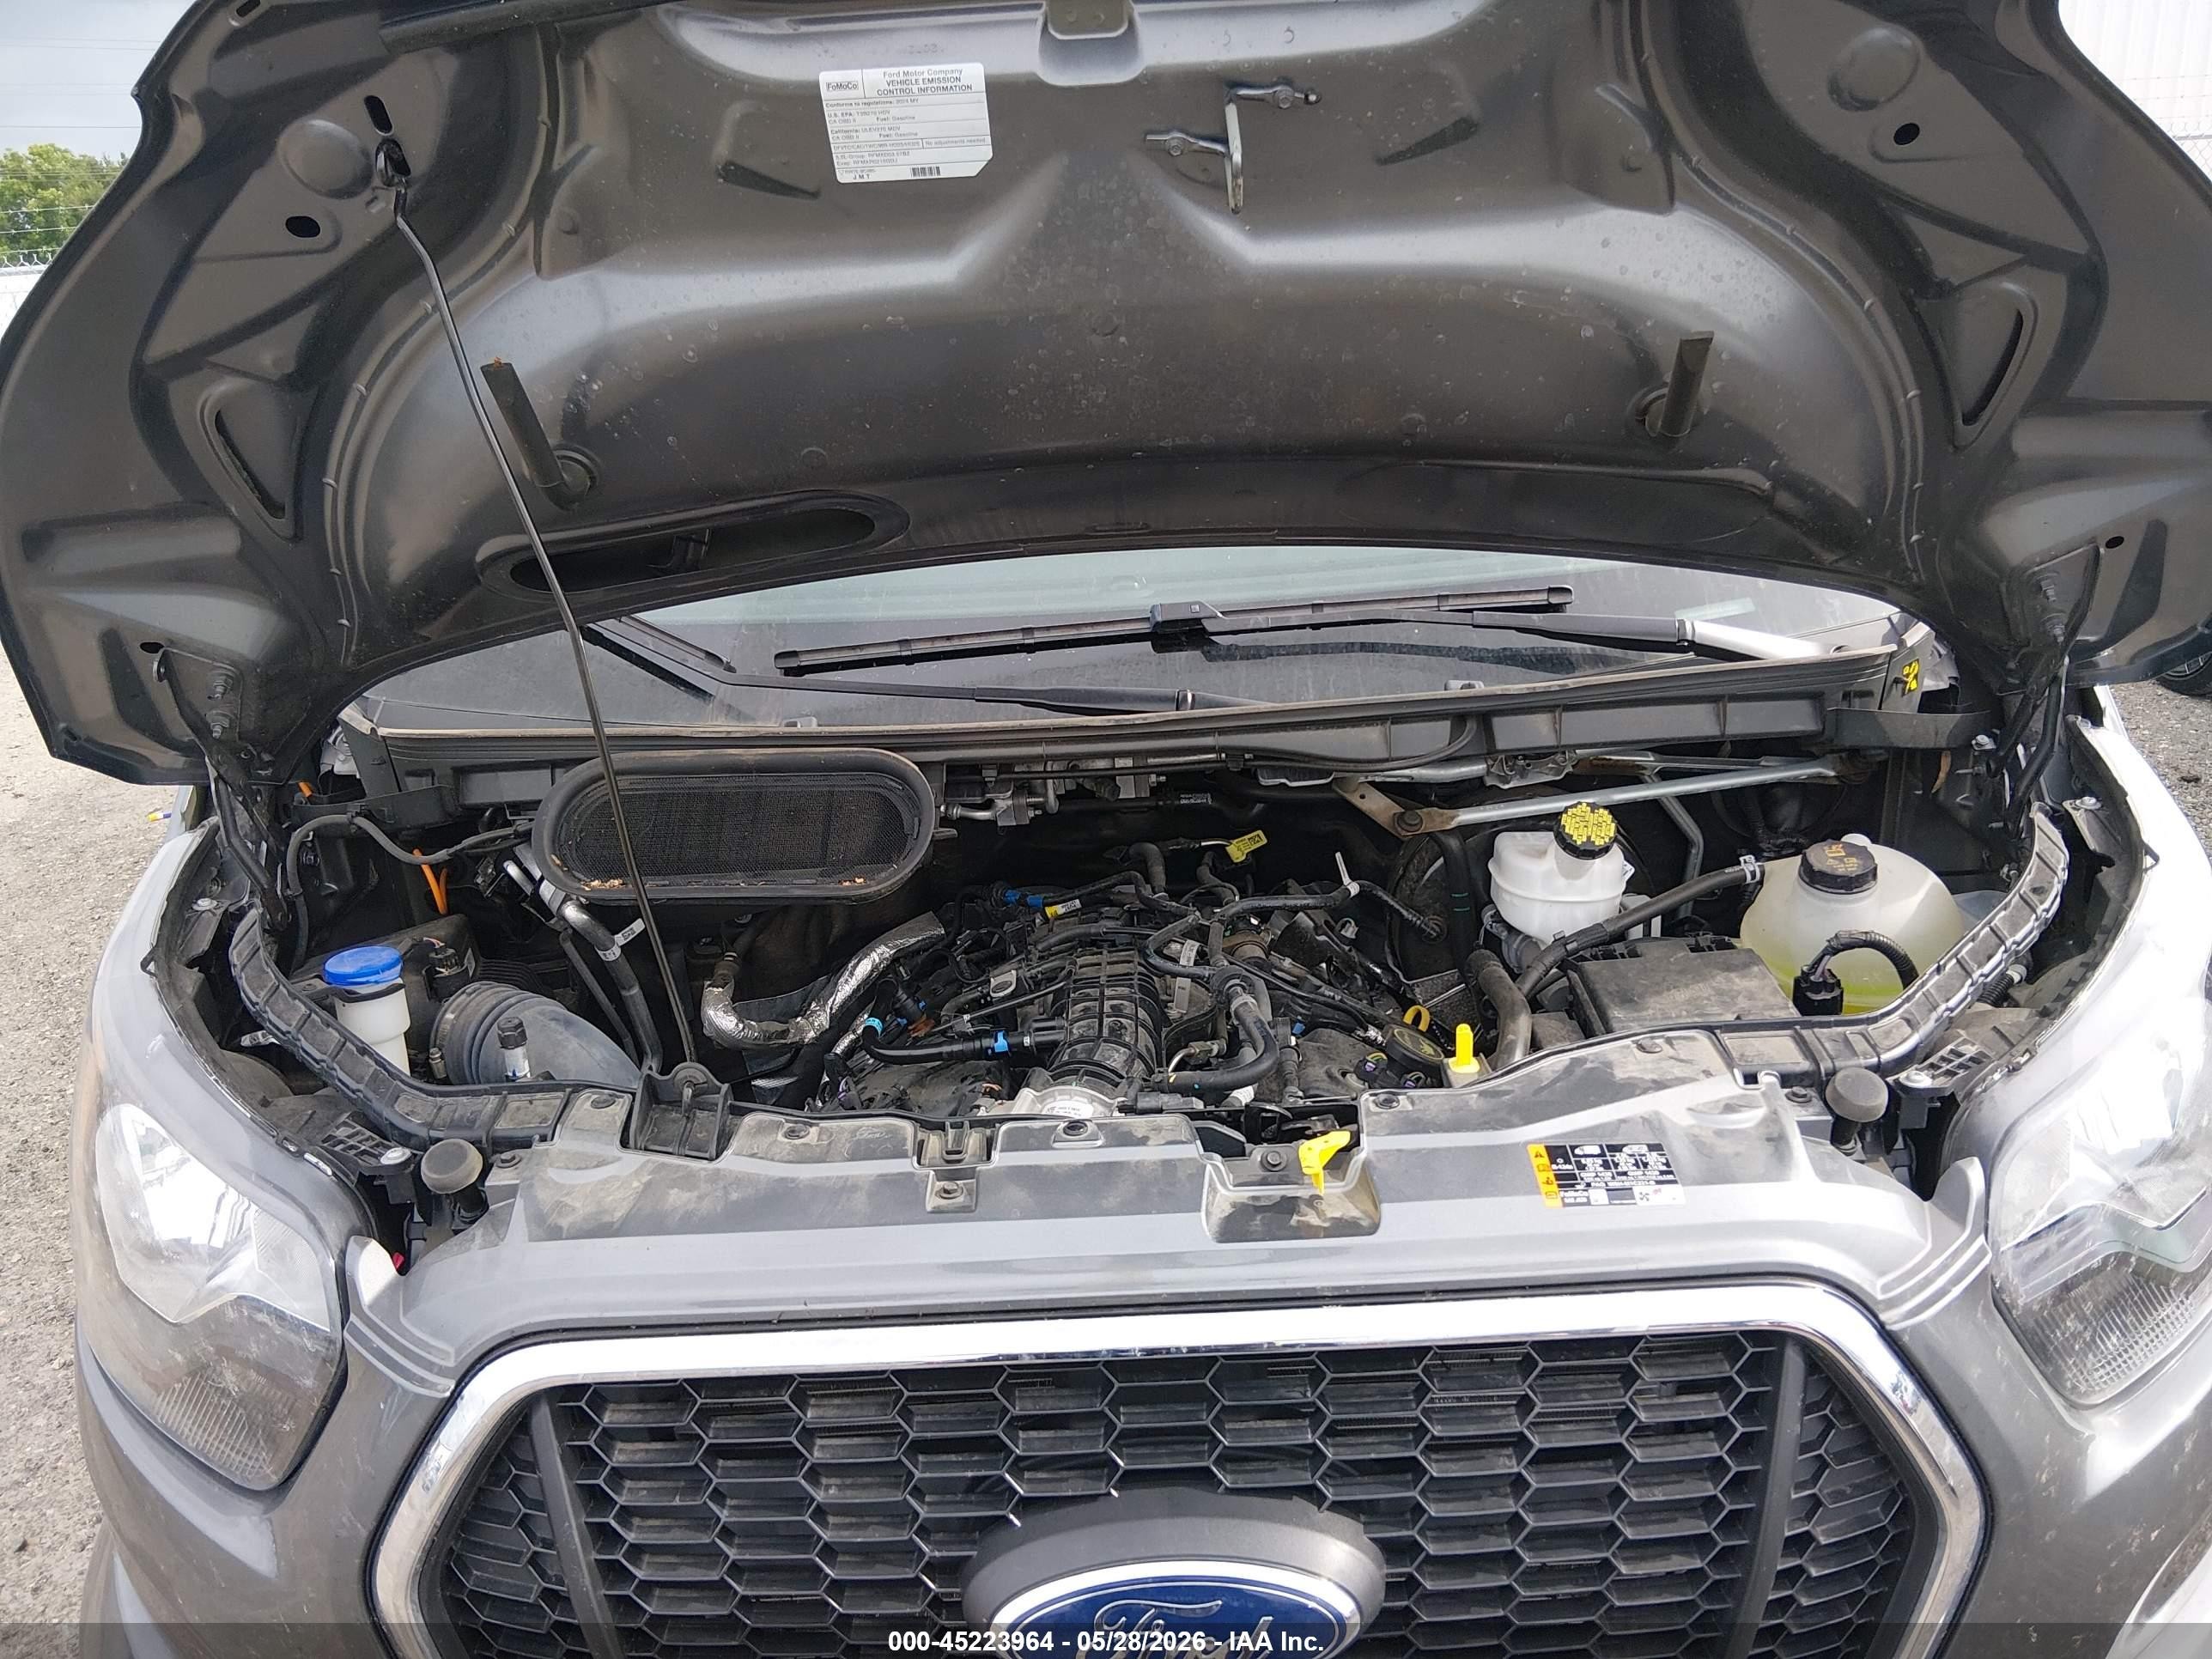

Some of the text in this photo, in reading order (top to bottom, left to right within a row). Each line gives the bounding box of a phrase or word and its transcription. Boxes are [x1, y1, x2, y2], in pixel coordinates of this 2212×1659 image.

[902, 70, 925, 78] Motor
[927, 69, 963, 78] Company
[826, 81, 858, 91] FoMoCo
[886, 76, 962, 87] VEHICLE EMISSION
[878, 83, 973, 96] CONTROL INFORMATION
